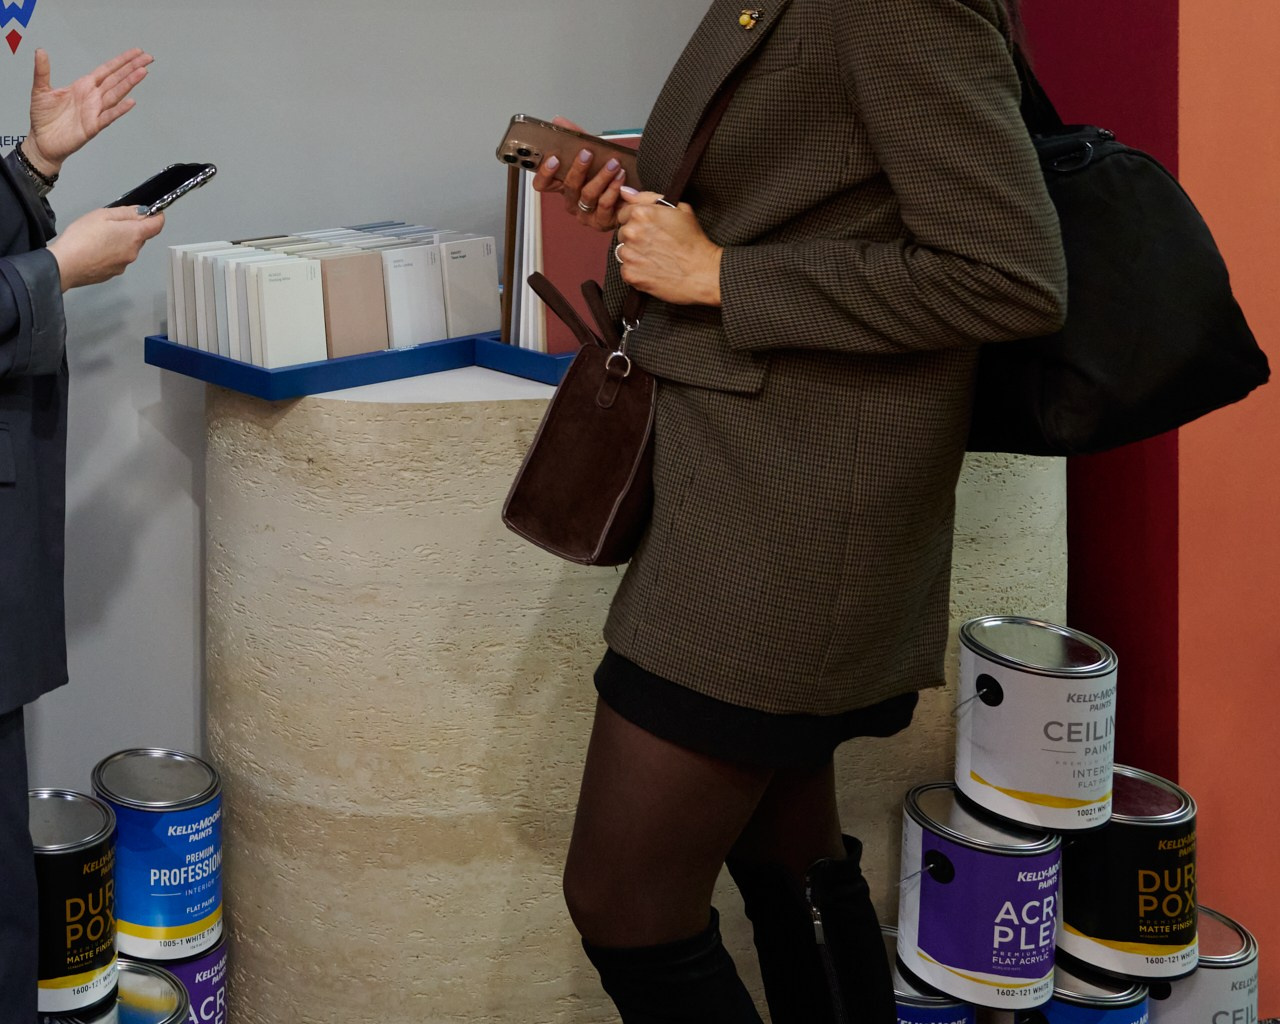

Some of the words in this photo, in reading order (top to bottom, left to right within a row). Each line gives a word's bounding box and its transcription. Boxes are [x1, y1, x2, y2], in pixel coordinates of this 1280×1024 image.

[1089, 699, 1112, 712] PAINTS
[1084, 741, 1112, 756] PAINT
[1078, 779, 1097, 789] FLAT
[1076, 808, 1096, 817] 10021
[188, 827, 213, 843] PAINTS
[185, 845, 214, 865] PREMIUM
[150, 845, 223, 886] PROFESSION
[1038, 875, 1057, 890] PAINTS
[186, 904, 201, 914] FLAT
[201, 895, 215, 909] PAINT
[1139, 887, 1195, 918] POX
[66, 908, 115, 949] POX
[1139, 925, 1170, 933] MATTE
[1172, 918, 1192, 932] FINISH
[159, 940, 183, 948] 1005-1
[185, 933, 206, 945] WHITE
[67, 950, 94, 965] MATTE
[992, 956, 1017, 965] FLAT
[1019, 951, 1049, 965] ACRYLIC
[1145, 956, 1179, 965] 1600-121
[996, 988, 1031, 997] 1602-121
